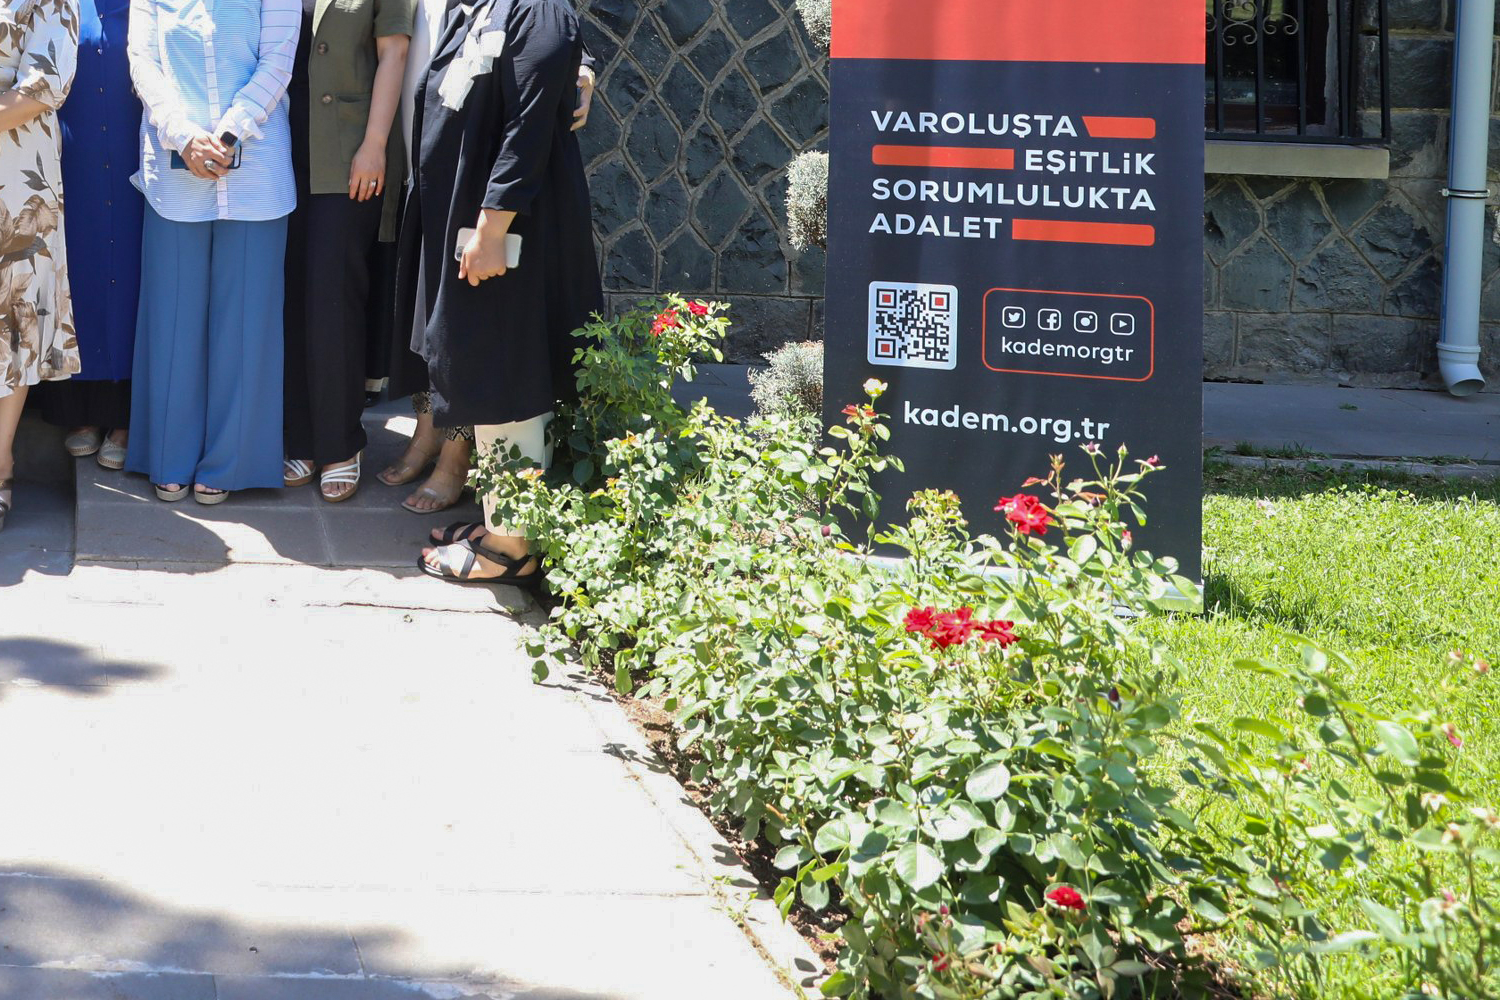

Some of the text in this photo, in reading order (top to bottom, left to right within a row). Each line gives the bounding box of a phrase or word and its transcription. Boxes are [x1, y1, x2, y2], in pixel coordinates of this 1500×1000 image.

[870, 110, 1078, 138] VAROLUŞTA
[871, 178, 1156, 211] SORUMLULUKTA
[868, 213, 1003, 239] ADALET
[1001, 337, 1135, 365] kademorgtr
[904, 400, 1111, 444] kadem.org.tr
